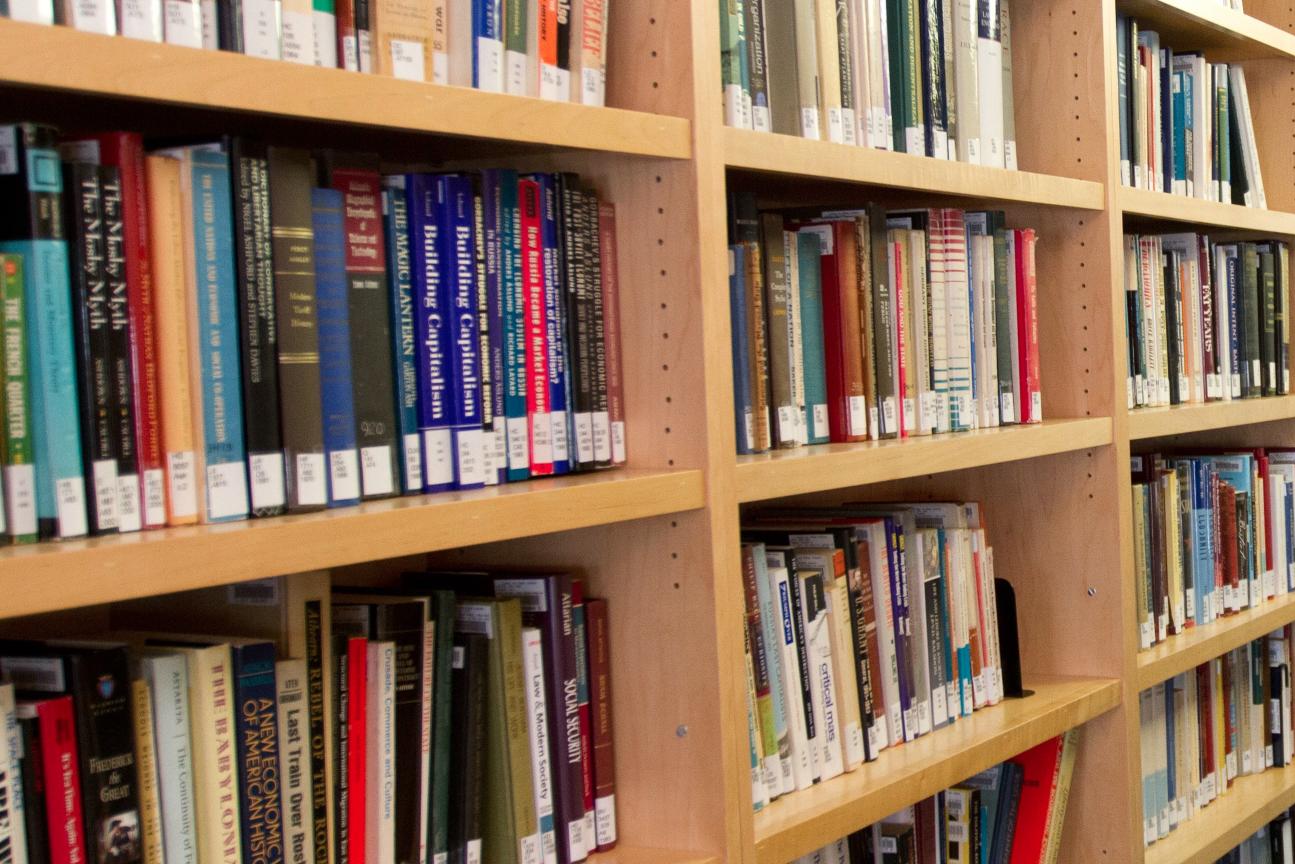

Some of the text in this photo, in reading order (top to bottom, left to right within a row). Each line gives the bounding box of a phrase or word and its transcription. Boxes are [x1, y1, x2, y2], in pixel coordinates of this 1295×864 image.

[751, 0, 762, 74] rganization
[240, 188, 251, 198] by
[243, 202, 254, 230] NIGEL
[251, 159, 266, 317] AND LIBERTARIAN THOUGHT
[474, 196, 484, 260] GORBACHEV'S
[527, 226, 539, 248] How
[82, 177, 108, 329] The Mosby Myth
[104, 180, 128, 330] The Mosby Myth
[244, 234, 256, 282] ASHFORD
[260, 160, 275, 344] A DICTIONARY OF CONSERVATIVE
[424, 224, 442, 308] Building
[456, 225, 476, 308] Building
[487, 230, 496, 274] IN RUSSIA
[504, 249, 513, 279] ANDERS
[528, 250, 540, 282] Russia
[247, 284, 258, 300] and
[394, 198, 414, 356] THE MAGIC LANTERN
[476, 263, 486, 310] STRUGGLE
[592, 266, 602, 316] STRUGGLE
[248, 303, 260, 346] STEPHEN
[530, 286, 542, 325] Became
[544, 247, 559, 384] restoration of capitalism?
[508, 332, 516, 365] RICHARD
[516, 318, 524, 350] SYSTEM
[596, 320, 604, 337] FOR
[1203, 307, 1212, 352] YEARS
[5, 298, 26, 438] THE FRENCH QUARTER
[250, 349, 261, 383] DAVIES
[425, 313, 445, 419] Capitalism
[458, 313, 478, 416] Capitalism
[480, 335, 490, 382] ECONOMIC
[494, 346, 502, 378] ANDERS
[518, 354, 525, 363] IN
[532, 336, 544, 372] Market
[596, 342, 606, 390] ECONOMIC
[482, 384, 491, 423] REFORM
[508, 368, 516, 396] LAYARD
[534, 375, 546, 412] Econom
[598, 395, 608, 412] REF
[562, 592, 572, 636] Attarian
[211, 664, 228, 715] THE
[310, 668, 324, 727] REBEL
[822, 662, 836, 708] critical
[242, 700, 258, 726] OF
[286, 708, 301, 742] Last
[384, 648, 392, 819] Crusade, Commerce and Culture
[562, 678, 582, 764] SOCIAL SECURITY
[176, 746, 188, 770] The
[312, 735, 324, 758] OF
[532, 674, 549, 800] Law & Modern Society
[245, 730, 264, 822] AMERICAN
[258, 698, 281, 858] A NEW ECONOMIC
[288, 748, 302, 788] Train
[314, 767, 326, 808] THE
[100, 786, 130, 802] GREAT
[178, 772, 192, 835] Continuity
[290, 793, 304, 828] Over
[182, 838, 192, 850] of
[315, 818, 328, 864] ROC
